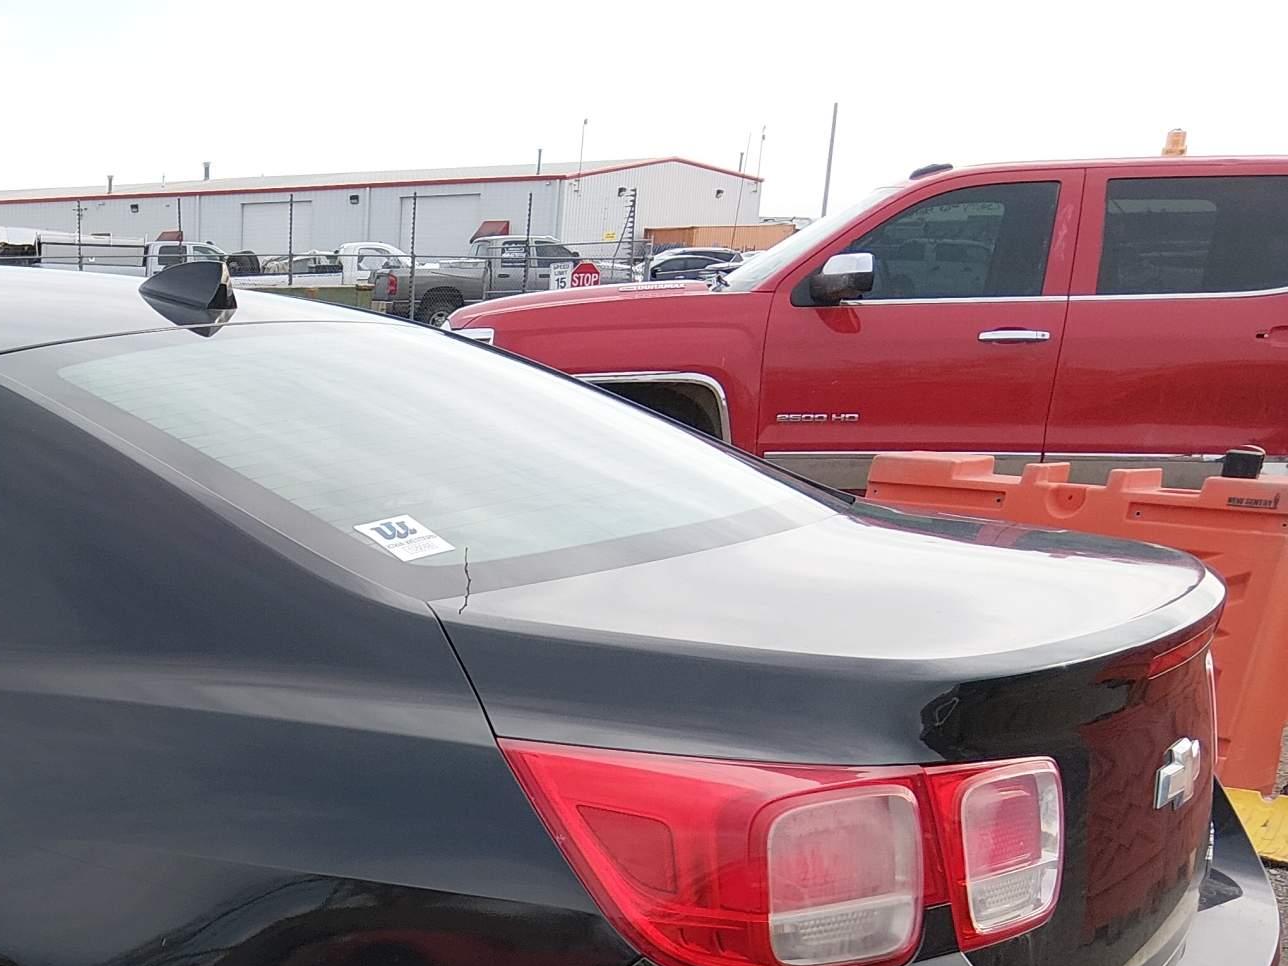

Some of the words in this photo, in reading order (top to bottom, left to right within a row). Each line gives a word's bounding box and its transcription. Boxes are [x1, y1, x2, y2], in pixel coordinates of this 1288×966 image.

[555, 277, 567, 289] 15
[572, 273, 599, 287] STOP
[776, 413, 828, 422] 2500
[831, 413, 859, 422] HD
